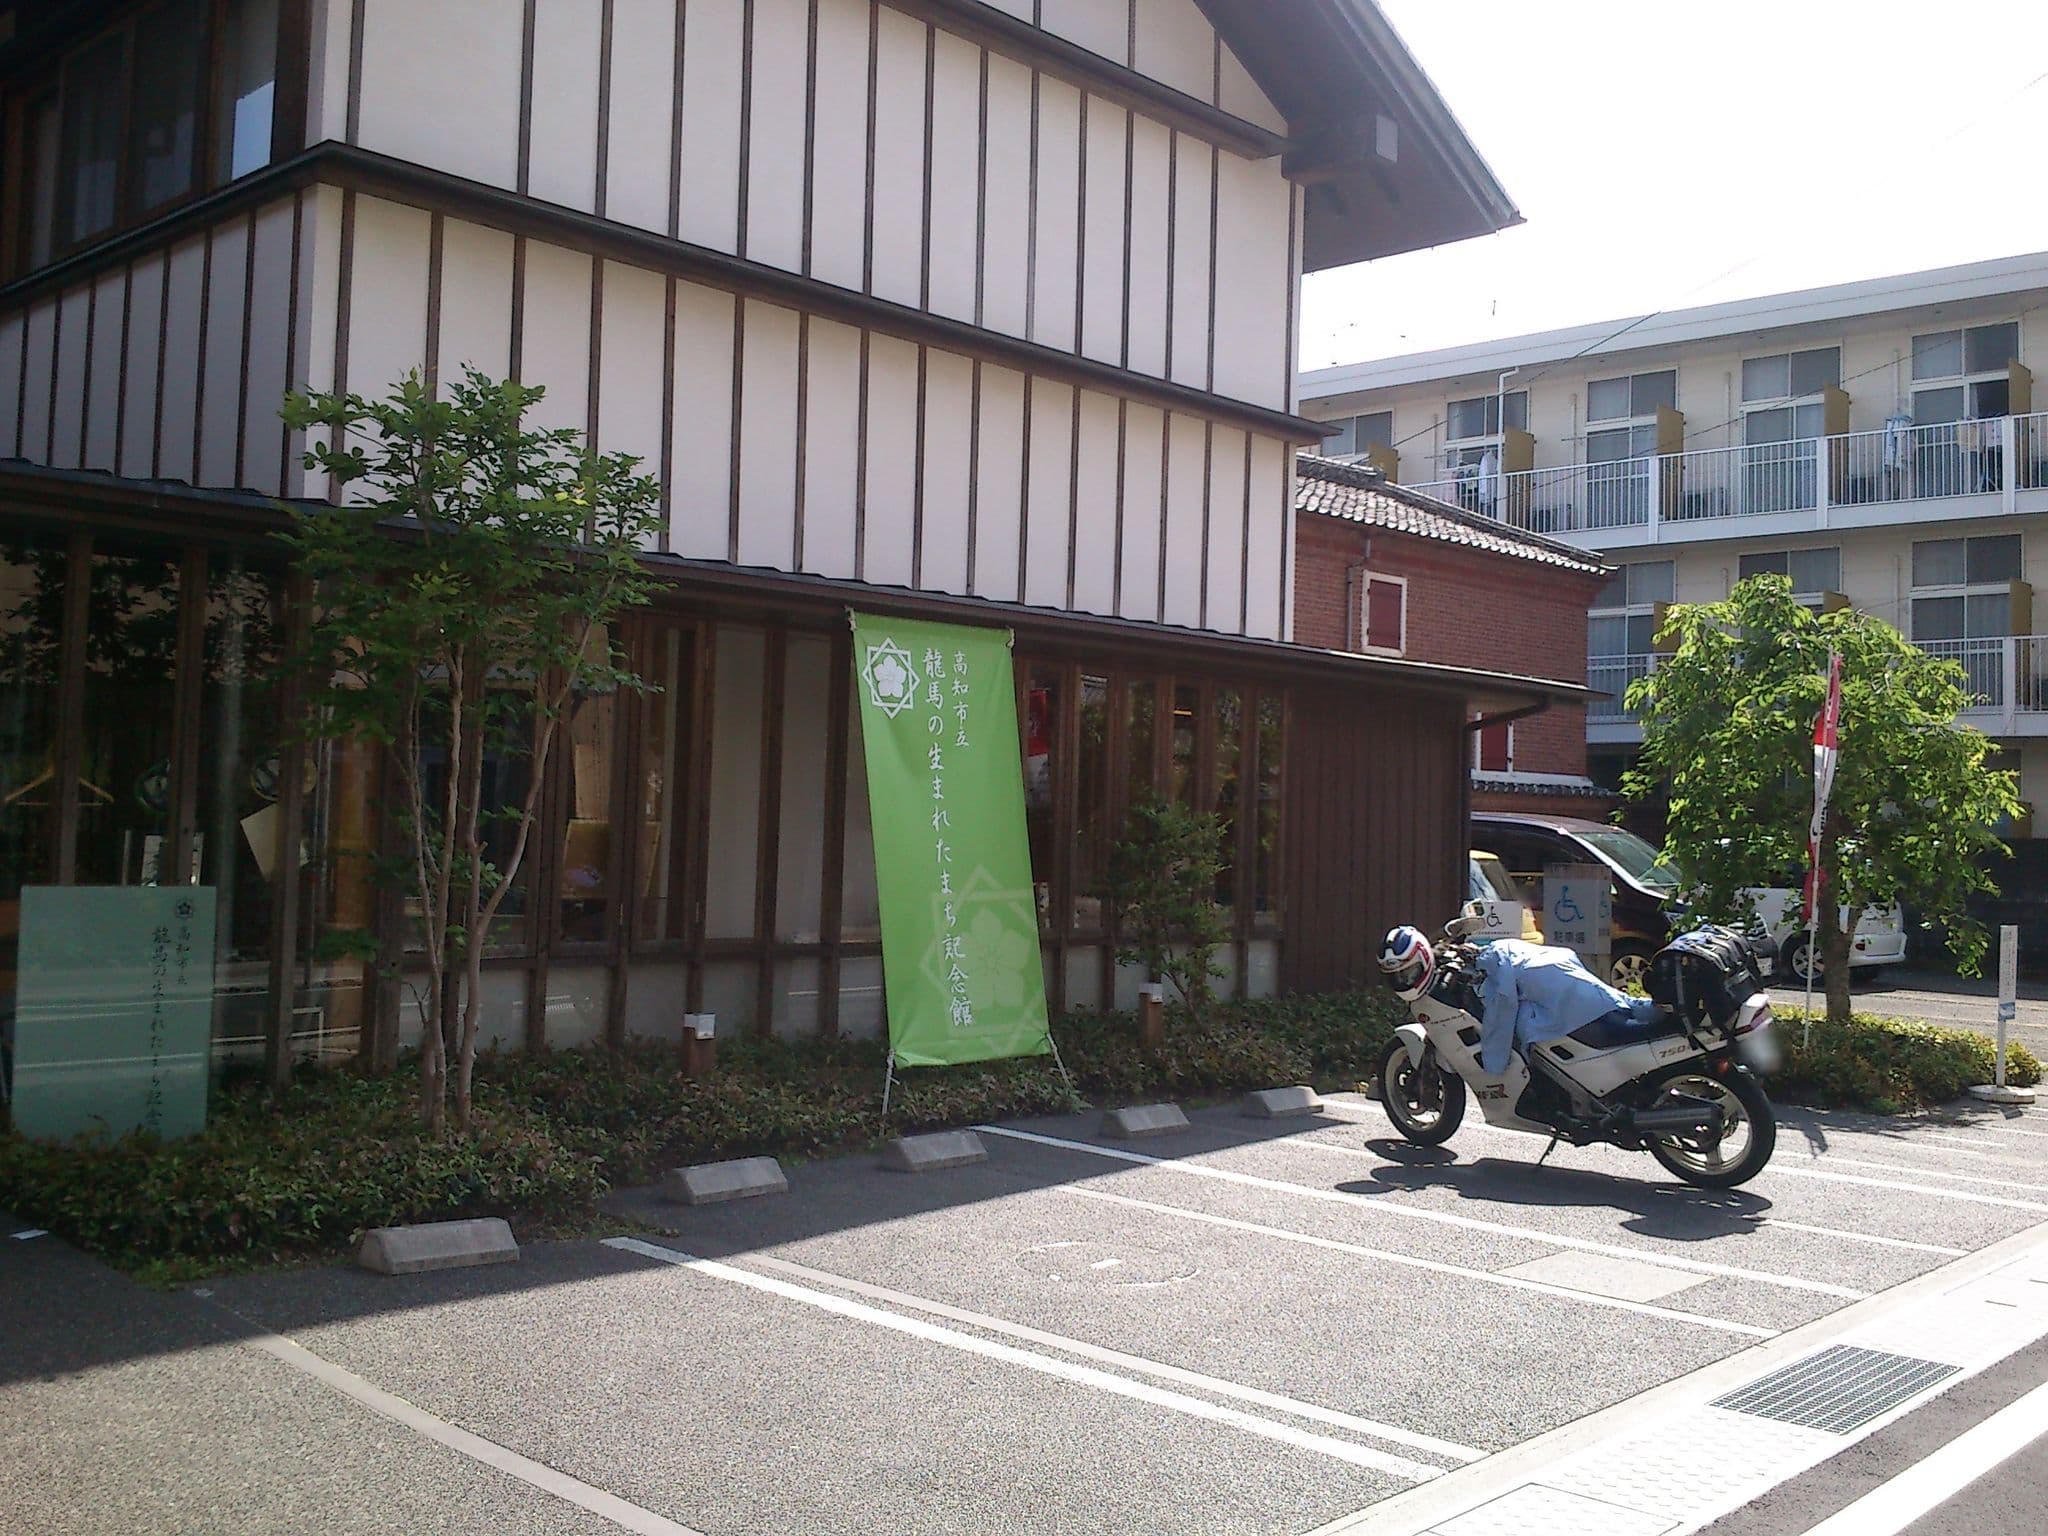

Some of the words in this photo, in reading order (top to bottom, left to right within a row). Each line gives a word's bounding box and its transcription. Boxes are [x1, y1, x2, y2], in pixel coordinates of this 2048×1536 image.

[951, 650, 970, 748] 高知市立
[923, 647, 974, 1027] 龍馬の生まれたまち記念館
